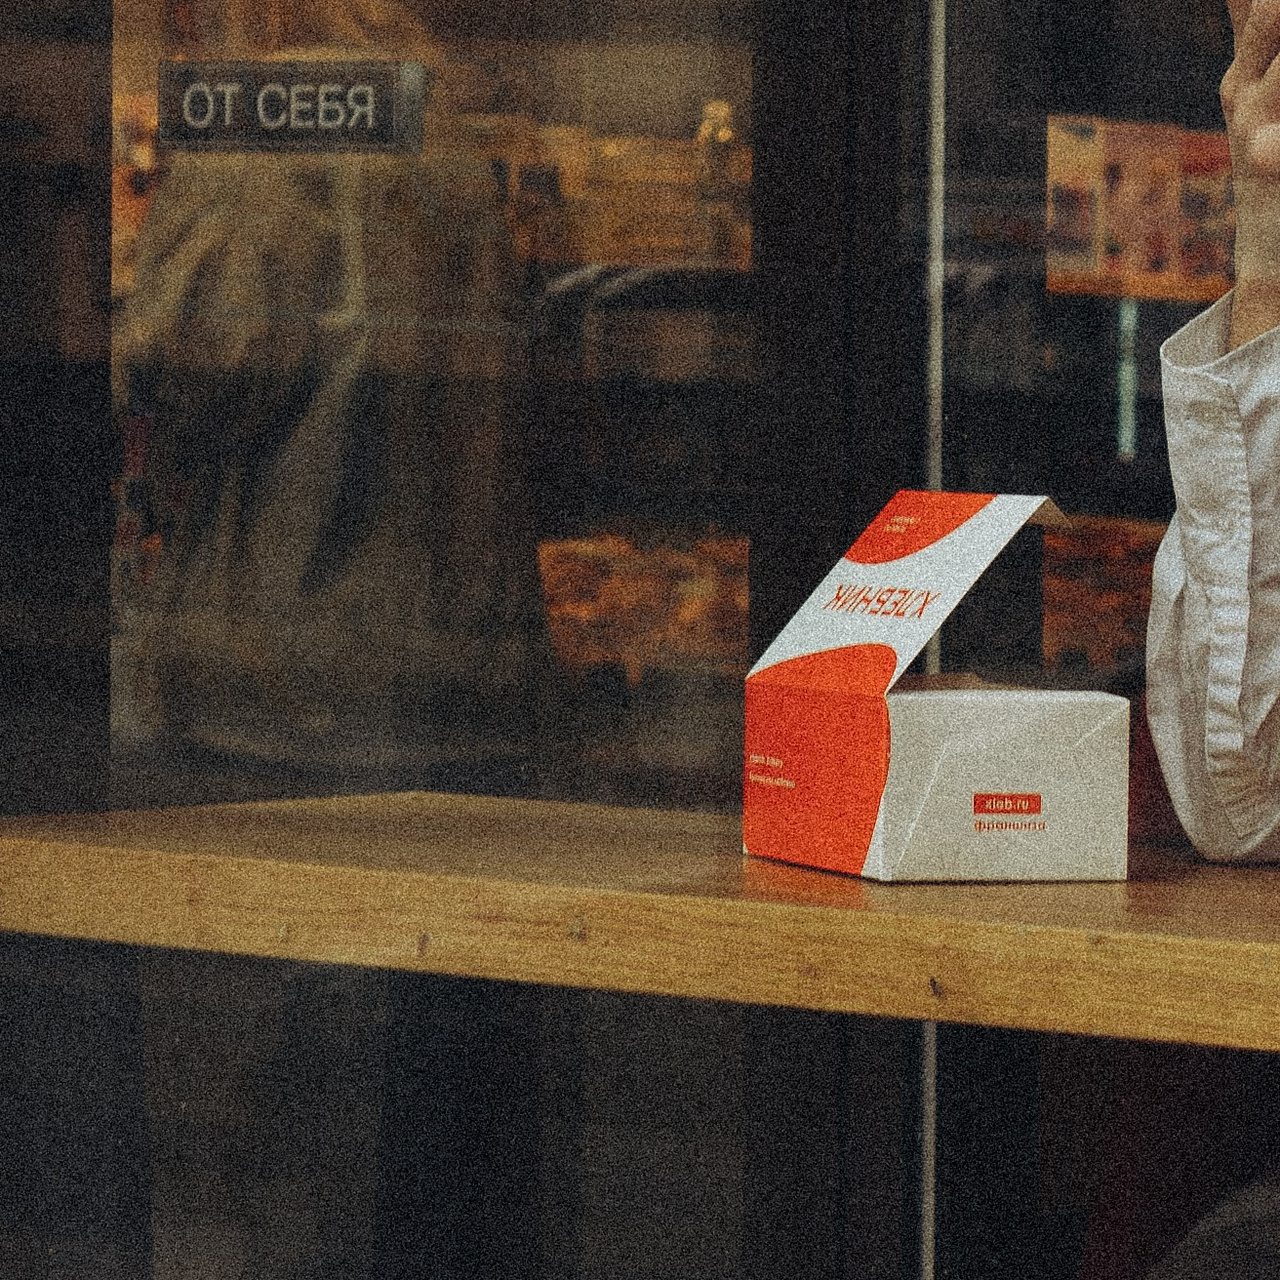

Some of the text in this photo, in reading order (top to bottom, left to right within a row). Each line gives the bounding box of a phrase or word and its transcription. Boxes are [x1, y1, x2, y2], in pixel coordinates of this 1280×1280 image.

[183, 82, 375, 130] ОТ СЕБЯ
[824, 584, 939, 618] ХЛЕБНИК
